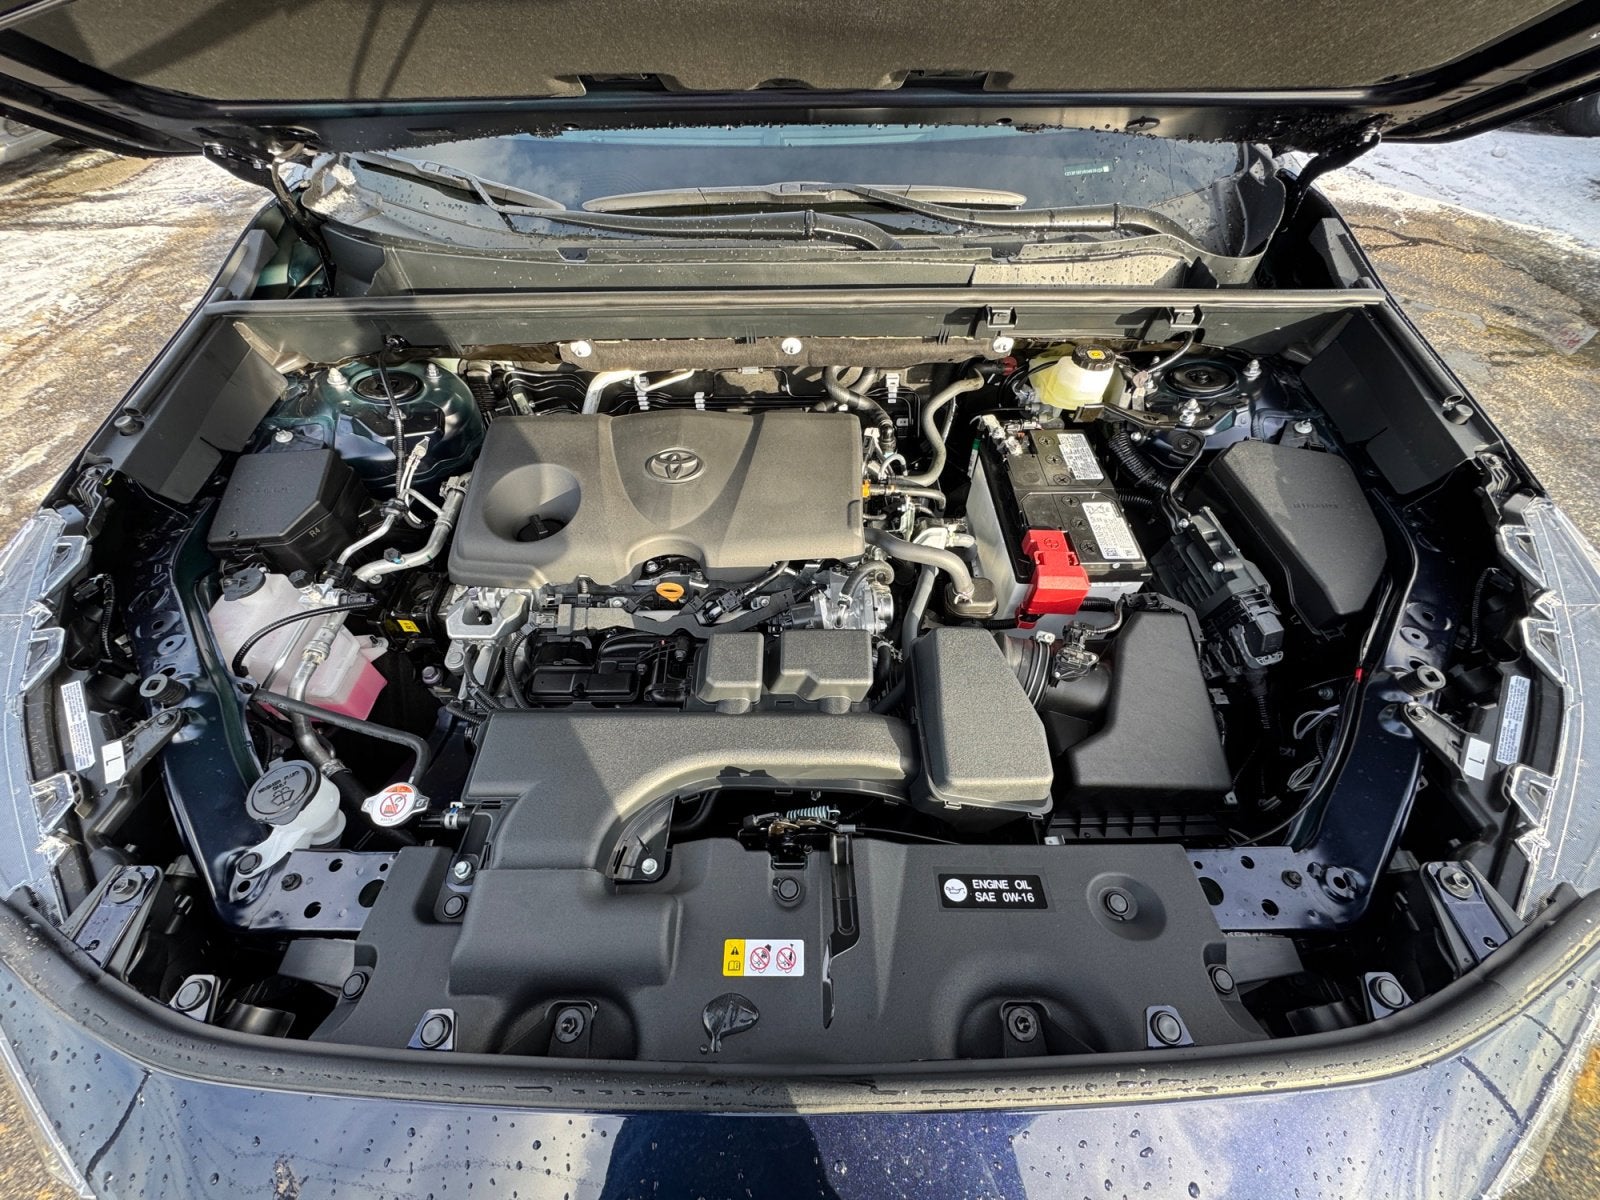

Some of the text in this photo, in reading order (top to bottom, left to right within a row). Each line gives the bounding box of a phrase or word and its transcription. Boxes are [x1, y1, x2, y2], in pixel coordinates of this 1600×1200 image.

[972, 879, 1032, 890] ENGINE OIL
[975, 892, 1035, 902] SAE 0W-16
